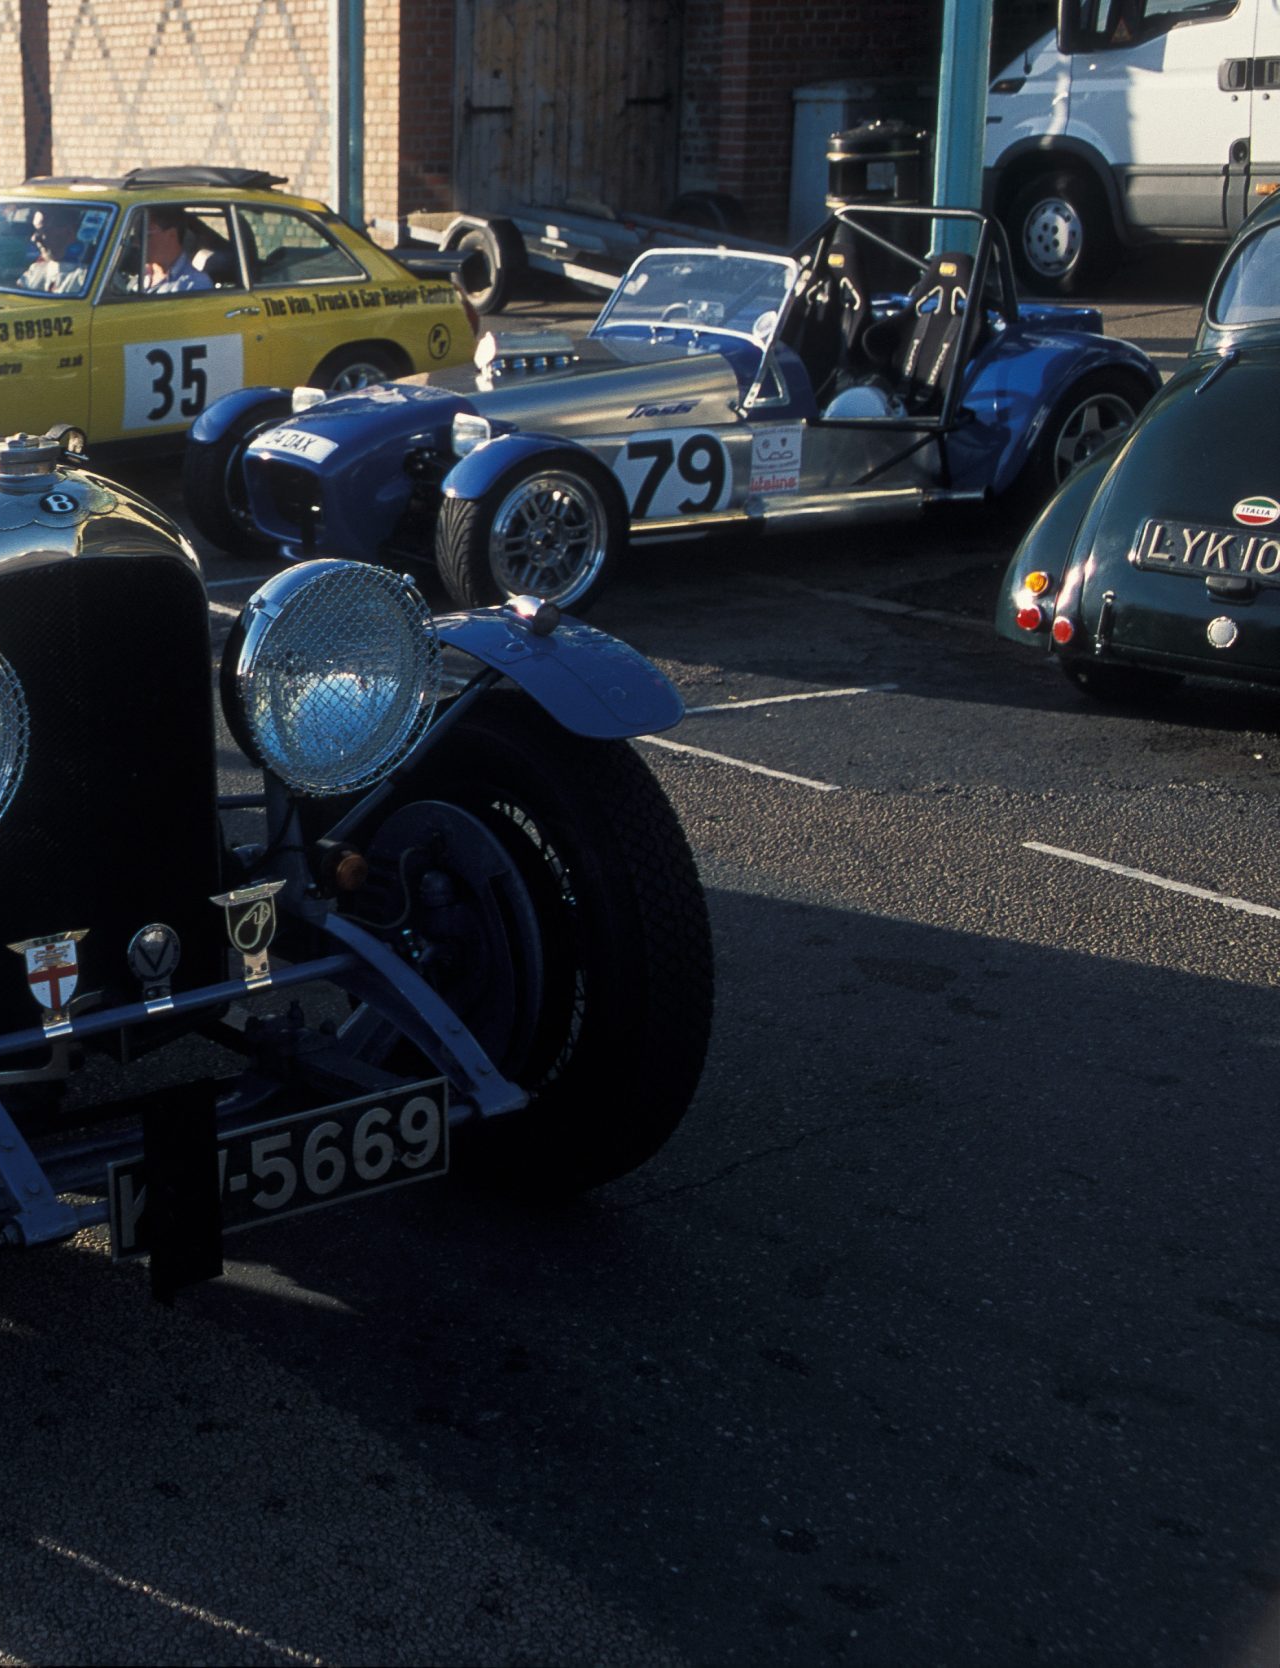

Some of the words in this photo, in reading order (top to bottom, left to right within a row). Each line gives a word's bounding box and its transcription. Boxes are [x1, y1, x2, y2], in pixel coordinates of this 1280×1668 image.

[261, 297, 287, 317] The
[285, 296, 315, 315] Van,
[312, 291, 349, 311] Truck
[359, 288, 381, 307] Car
[14, 315, 73, 340] 681942
[145, 344, 208, 421] 35
[281, 434, 319, 452] DAX
[627, 434, 727, 519] 79
[45, 494, 74, 512] B
[1241, 506, 1271, 516] ITALIA
[1148, 525, 1237, 569] LYK
